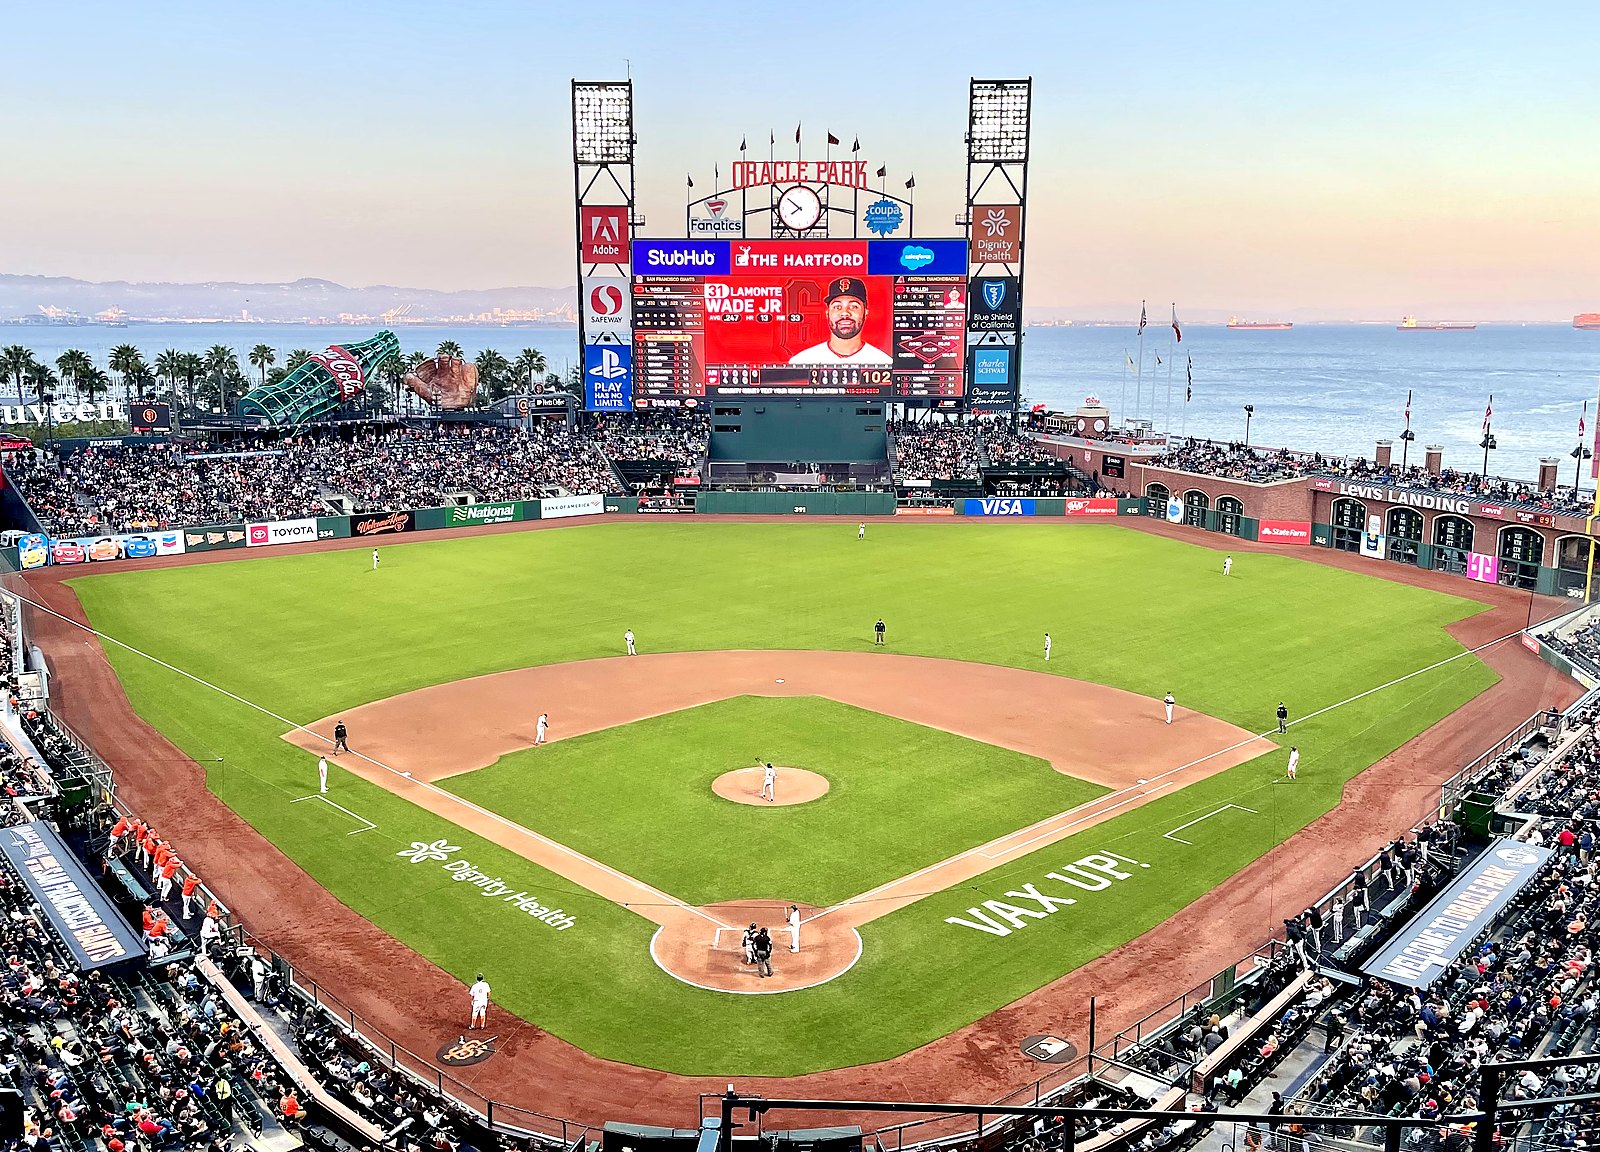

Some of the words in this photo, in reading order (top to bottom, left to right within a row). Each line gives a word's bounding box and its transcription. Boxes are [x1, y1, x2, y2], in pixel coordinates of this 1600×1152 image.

[732, 161, 808, 190] ORACLE
[816, 161, 868, 190] PARK
[869, 206, 900, 217] coupa
[691, 219, 742, 231] Fanatics
[592, 245, 619, 255] Adobe
[978, 240, 1013, 251] Dignity
[647, 249, 715, 265] StubHub
[751, 254, 777, 266] THE
[783, 254, 864, 266] HARTFORD
[904, 254, 932, 262] salesforce
[709, 285, 723, 297] 31
[730, 287, 782, 296] LAMONTE
[705, 299, 754, 313] WADE
[759, 299, 781, 313] JR
[978, 359, 1005, 367] charles
[594, 383, 622, 392] PLAY
[990, 391, 1010, 399] your
[979, 500, 1023, 515] VISA
[1387, 489, 1470, 515] LANDING
[467, 505, 516, 520] National
[272, 526, 314, 538] TOYOTA
[1315, 536, 1327, 545] 365
[1473, 864, 1521, 890] PARK
[442, 860, 515, 897] Dignity
[503, 891, 576, 931] Health
[944, 882, 1078, 937] VAX
[1044, 850, 1151, 892] UP!
[1442, 886, 1500, 922] ORACLE
[1430, 915, 1469, 934] TO
[71, 923, 127, 963] GIANTS
[1381, 924, 1457, 981] WELCOME
